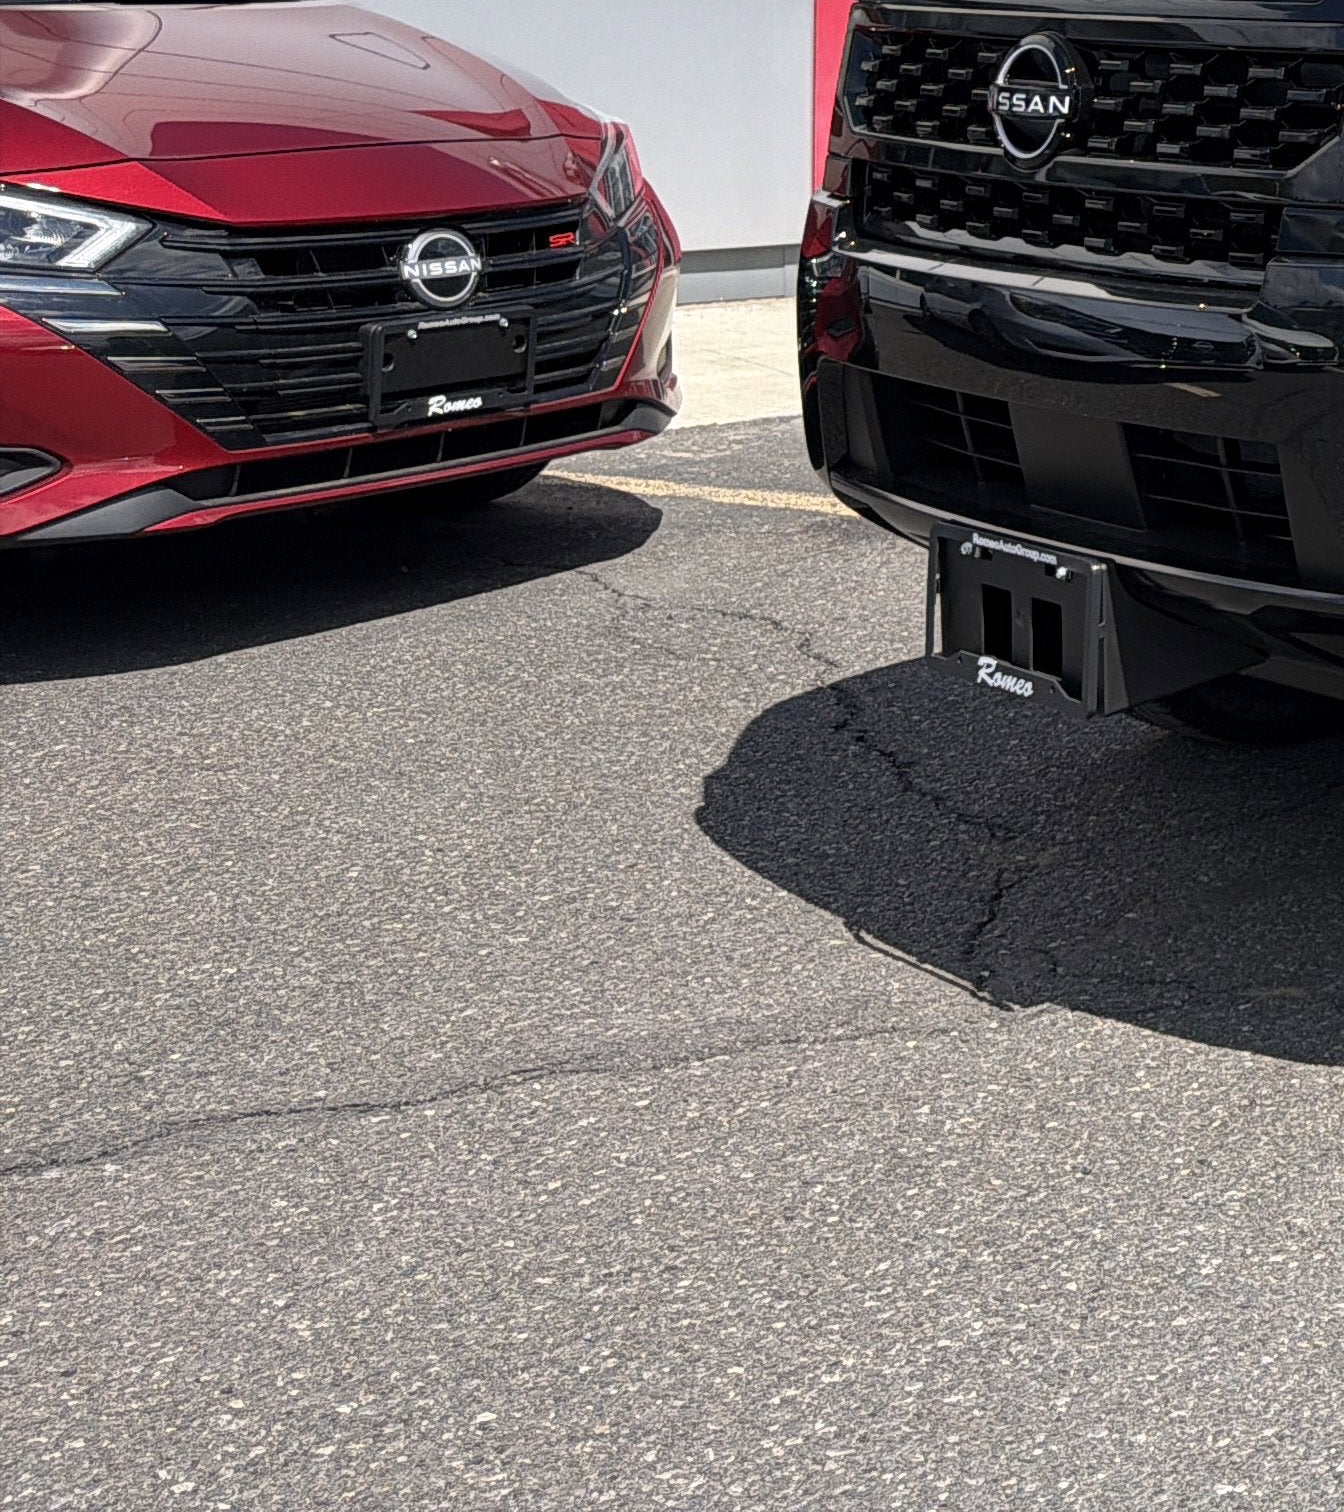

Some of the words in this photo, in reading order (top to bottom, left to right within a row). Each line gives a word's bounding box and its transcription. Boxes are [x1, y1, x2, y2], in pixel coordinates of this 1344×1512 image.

[549, 232, 575, 248] SR
[403, 256, 481, 279] NISSAN
[427, 394, 483, 418] Romeo
[976, 655, 1034, 697] Romeo
